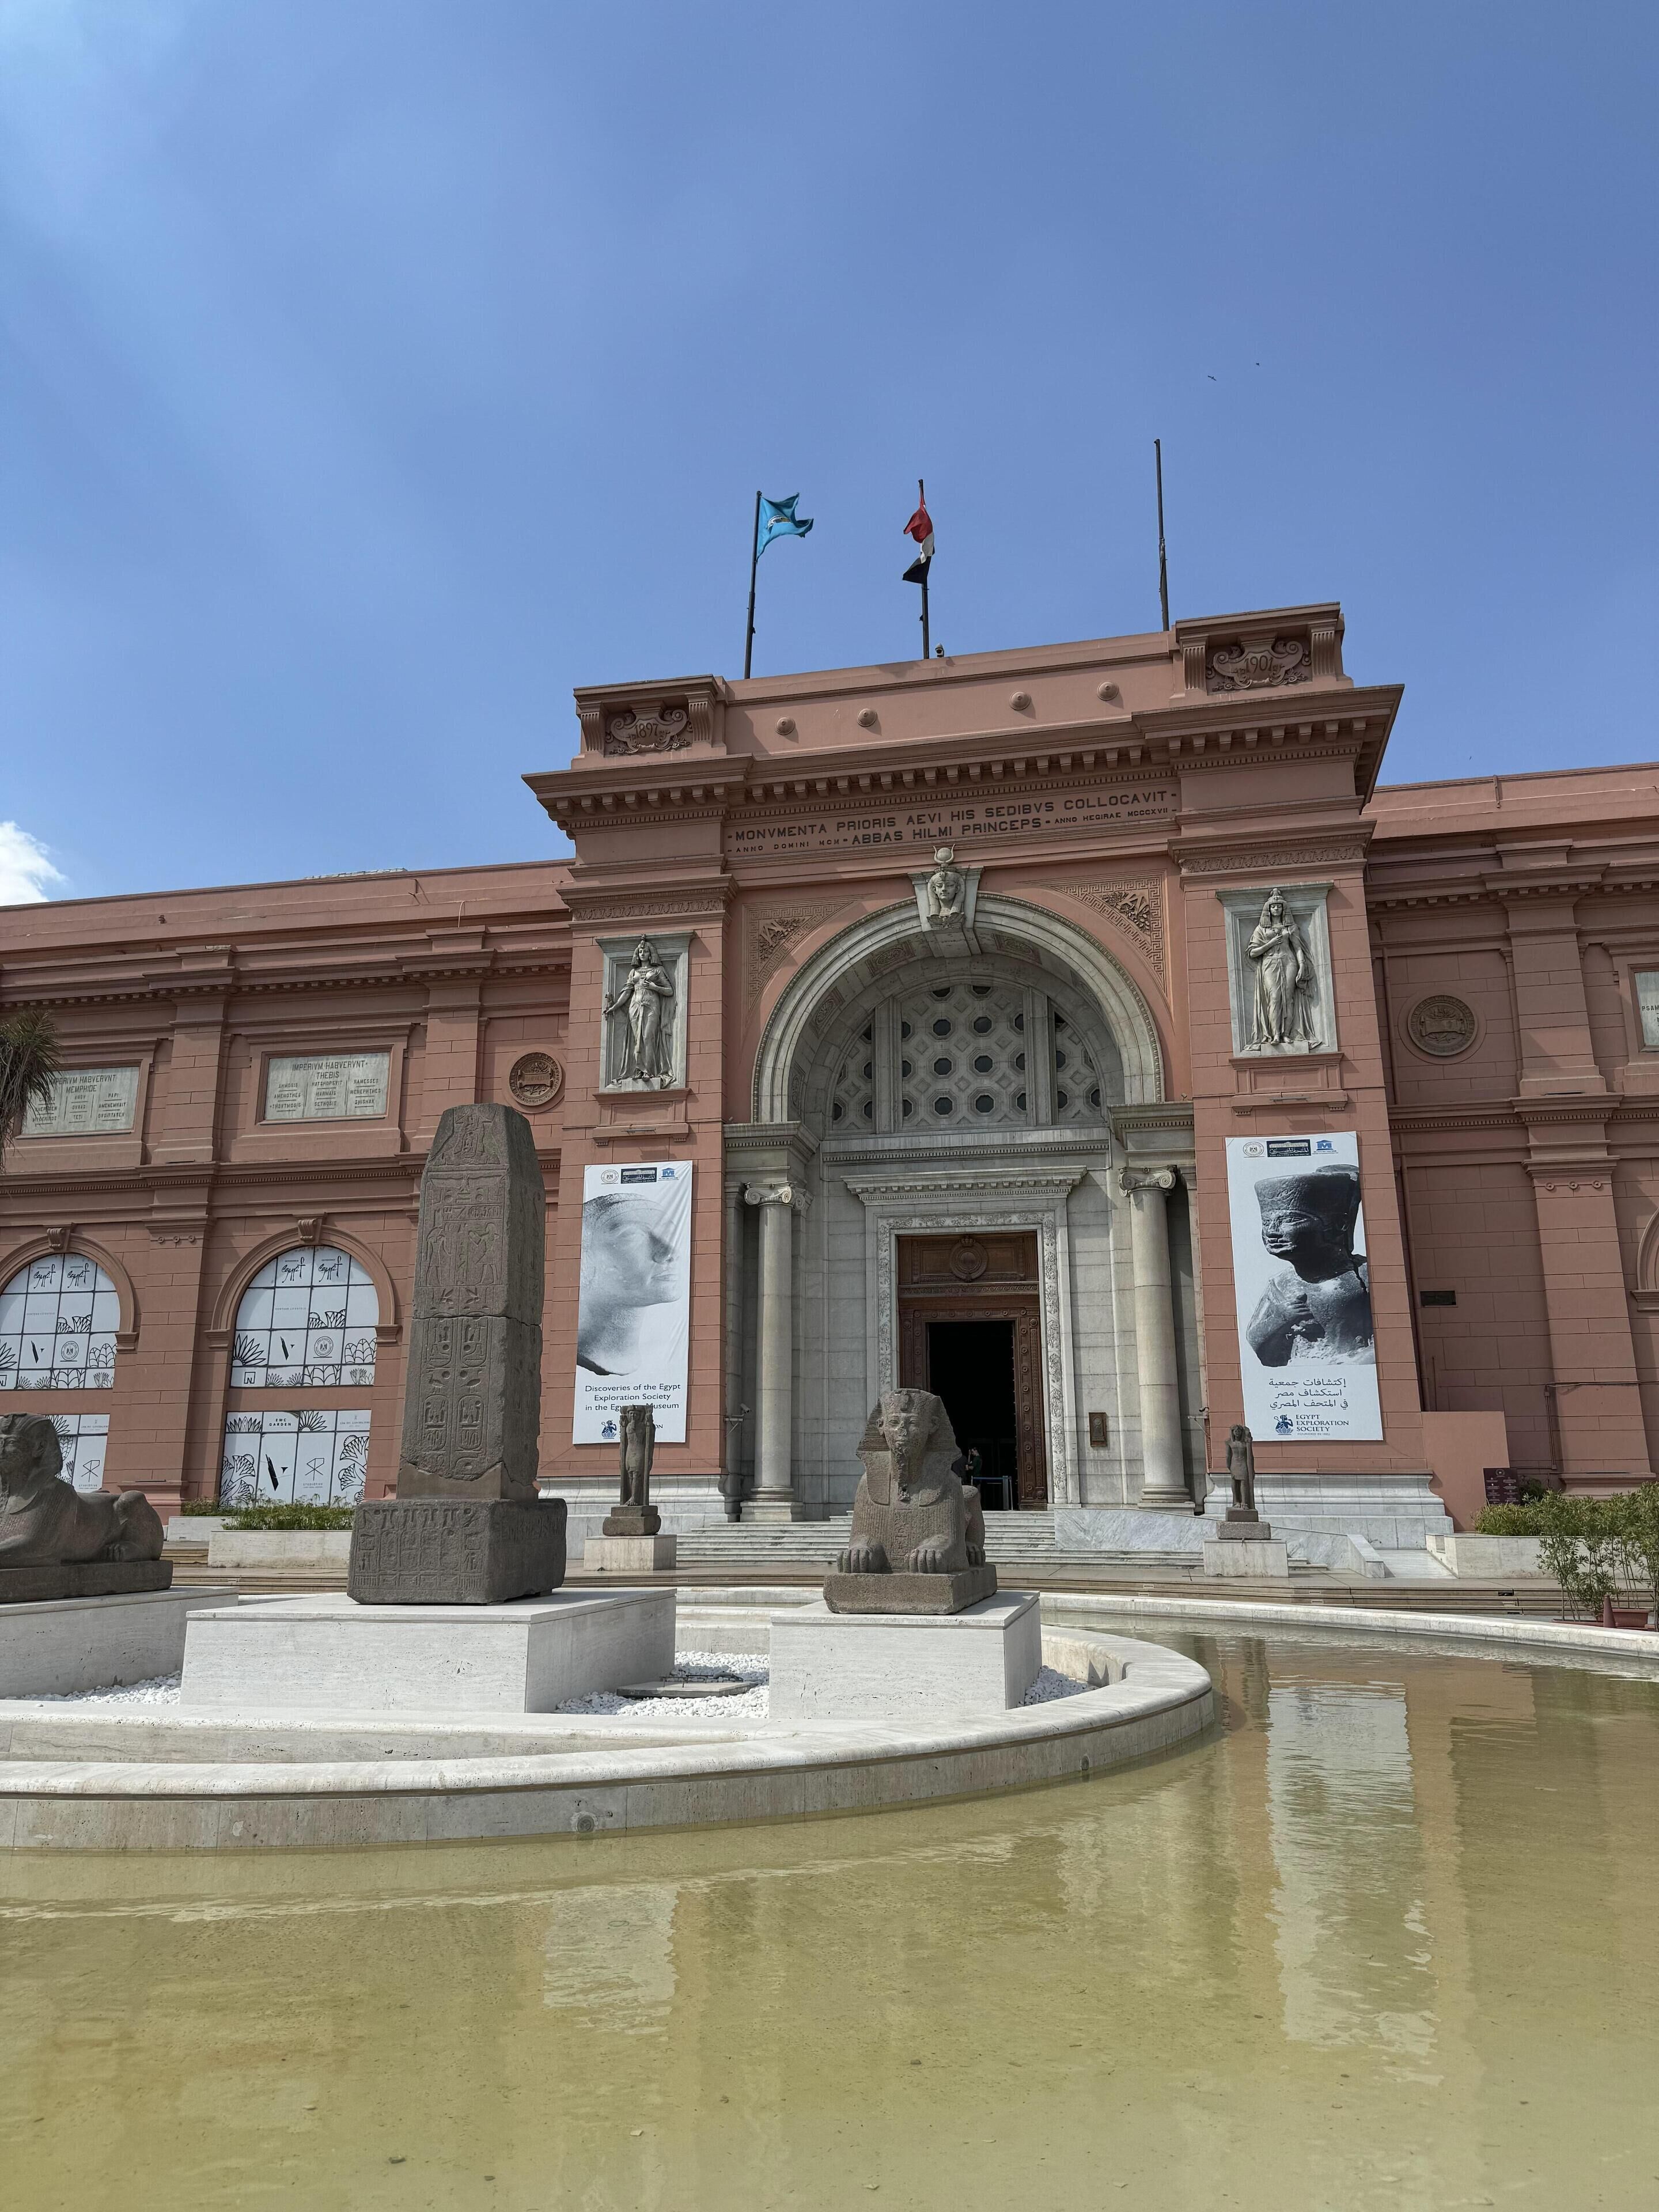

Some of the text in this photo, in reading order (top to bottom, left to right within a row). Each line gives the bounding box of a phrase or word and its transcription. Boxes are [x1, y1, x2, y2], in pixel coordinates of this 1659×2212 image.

[1244, 656, 1273, 673] 1901
[635, 722, 658, 737] 1897
[736, 791, 1167, 841] MONVMENTA PRIORIS AEVI HIS SEDIBVS COLLOCAVIT
[774, 842, 809, 850] DOMINI
[852, 831, 903, 845] ABBAS
[912, 826, 952, 840] HILMI
[962, 818, 1041, 835] PRINCEPS
[1083, 812, 1121, 821] HEGIRAE
[1128, 808, 1168, 817] MCCCXVII
[293, 1063, 323, 1071] IMPERIVM
[79, 1074, 116, 1084] HABVERVNT
[317, 1071, 340, 1080] THEBIS
[66, 1085, 97, 1093] MEMPHIDE
[659, 1383, 681, 1391] Egypt
[1269, 1378, 1299, 1388] جمعية
[1298, 1388, 1342, 1396] استكشاف
[594, 1394, 639, 1403] Exploration
[1270, 1399, 1299, 1410] المصري
[1340, 1399, 1349, 1410] في
